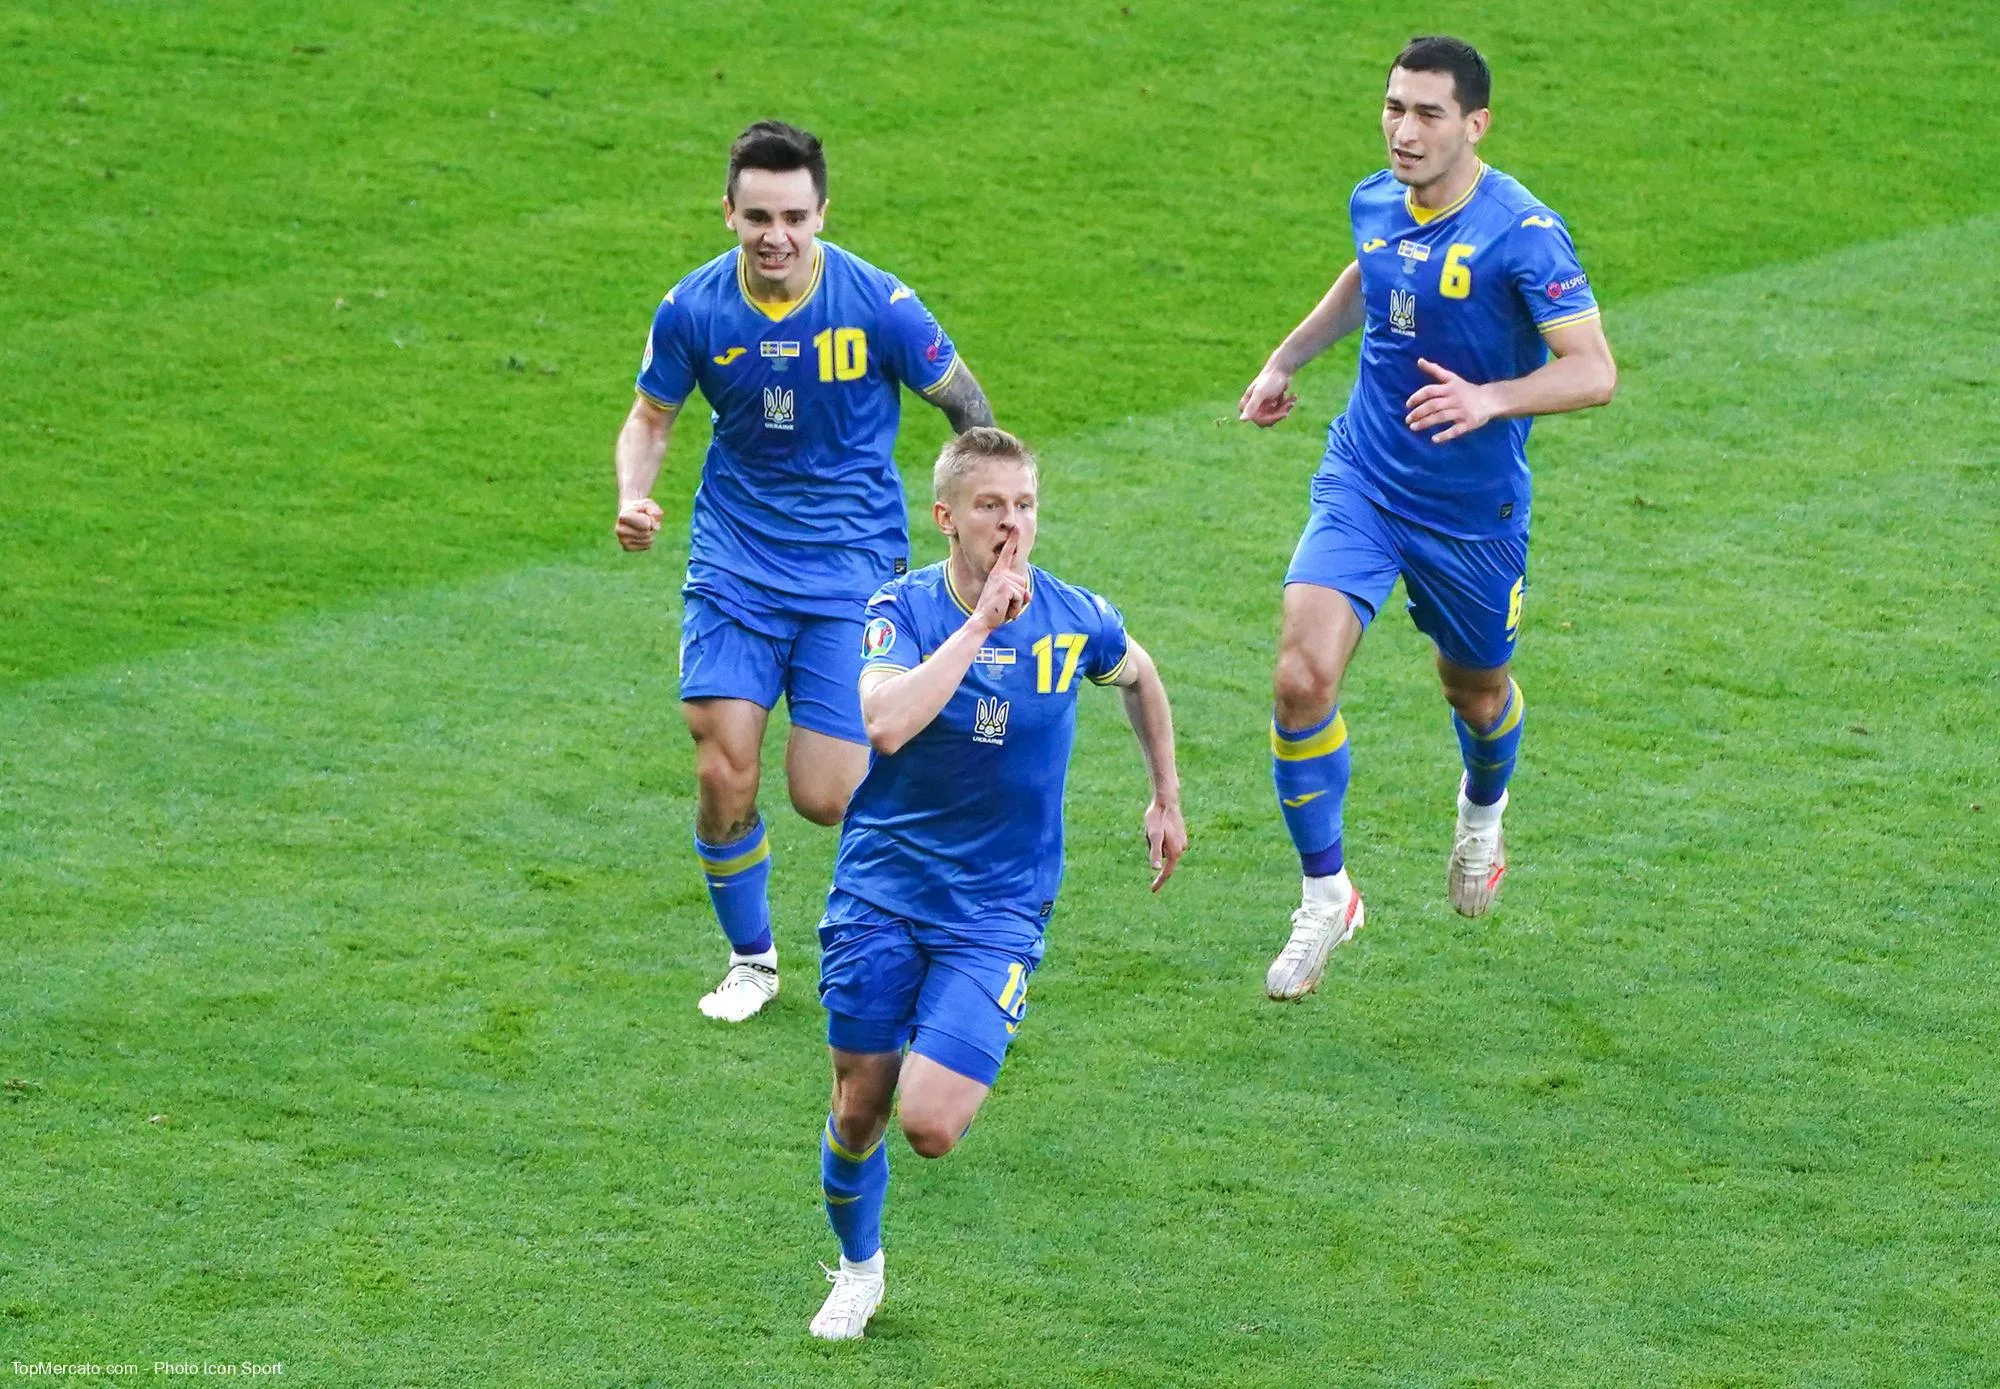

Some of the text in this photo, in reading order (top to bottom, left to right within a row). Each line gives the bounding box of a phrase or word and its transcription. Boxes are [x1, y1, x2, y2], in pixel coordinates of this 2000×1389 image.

[1439, 244, 1476, 299] 6
[813, 327, 867, 382] 10
[1032, 633, 1088, 693] 17
[972, 736, 1003, 745] UKRAINE
